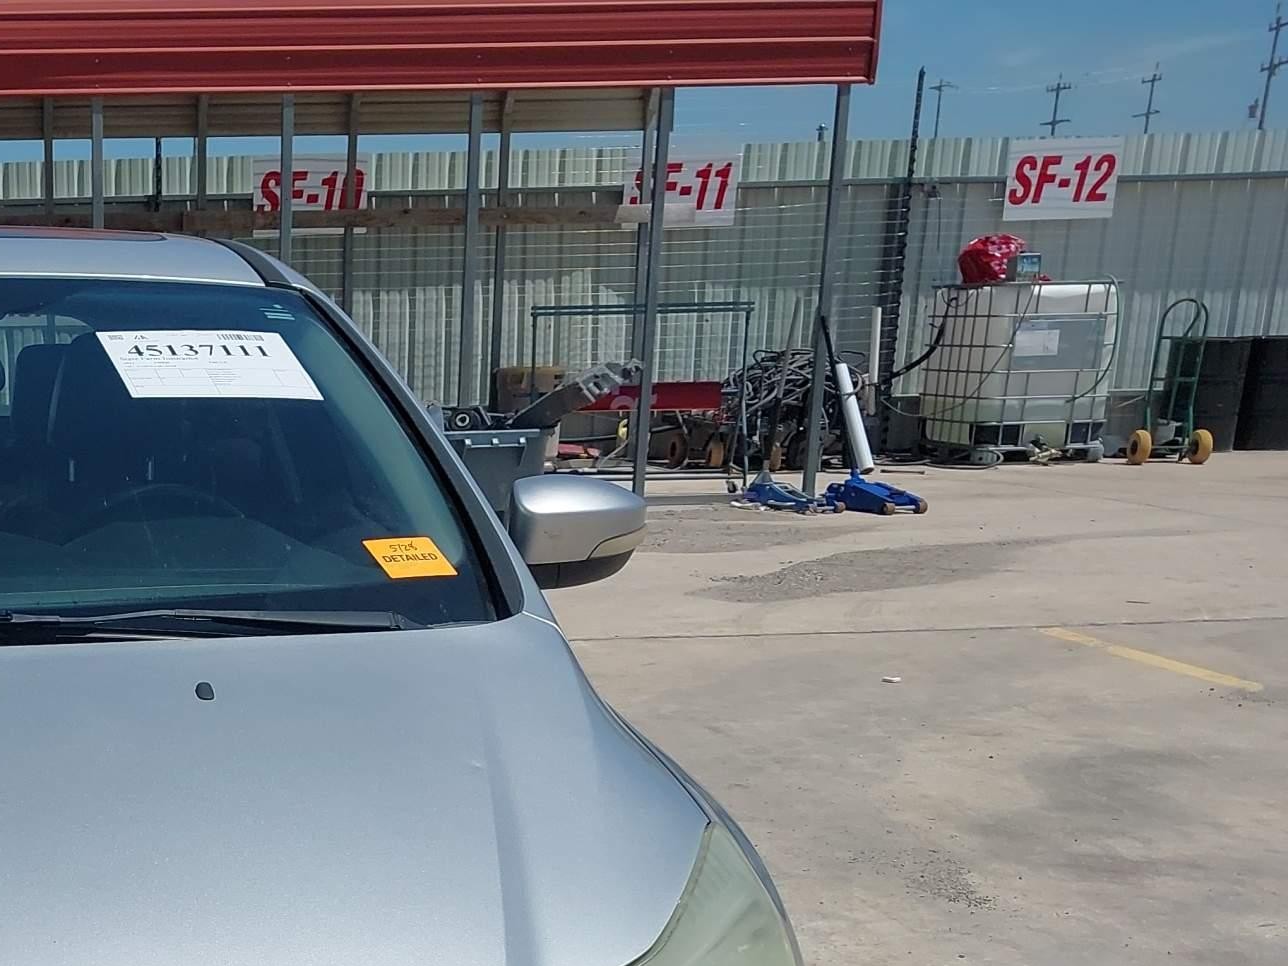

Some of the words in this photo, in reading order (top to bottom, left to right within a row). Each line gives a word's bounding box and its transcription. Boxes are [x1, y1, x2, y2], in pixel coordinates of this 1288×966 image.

[1009, 153, 1116, 205] SF-12
[127, 344, 272, 357] 45137111
[382, 552, 438, 563] DETAILED
